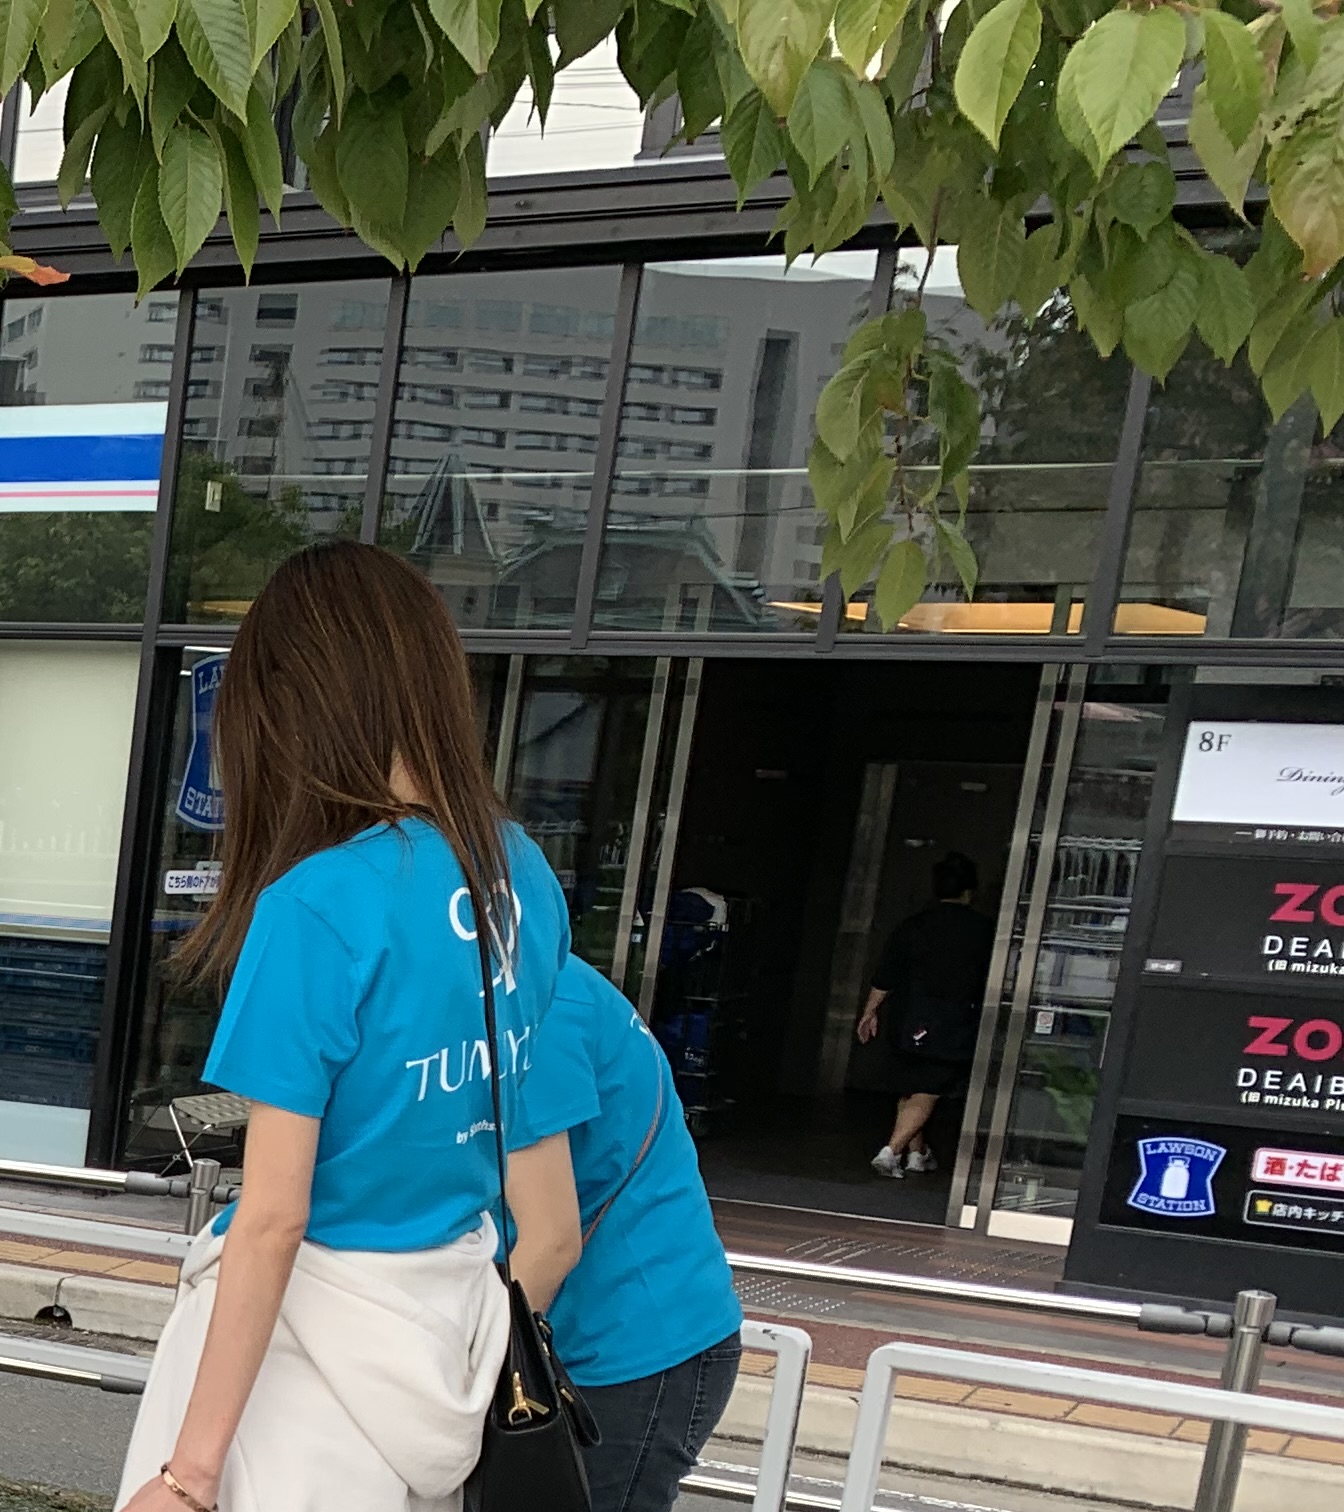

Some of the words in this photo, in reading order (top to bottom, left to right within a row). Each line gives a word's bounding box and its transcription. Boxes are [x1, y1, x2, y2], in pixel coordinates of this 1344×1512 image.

[1198, 730, 1233, 752] 8F
[1263, 935, 1344, 960] DEA
[1263, 1093, 1320, 1109] mizuka
[455, 1131, 469, 1144] by
[1145, 1142, 1218, 1162] LAWSON
[1136, 1192, 1207, 1212] STATION
